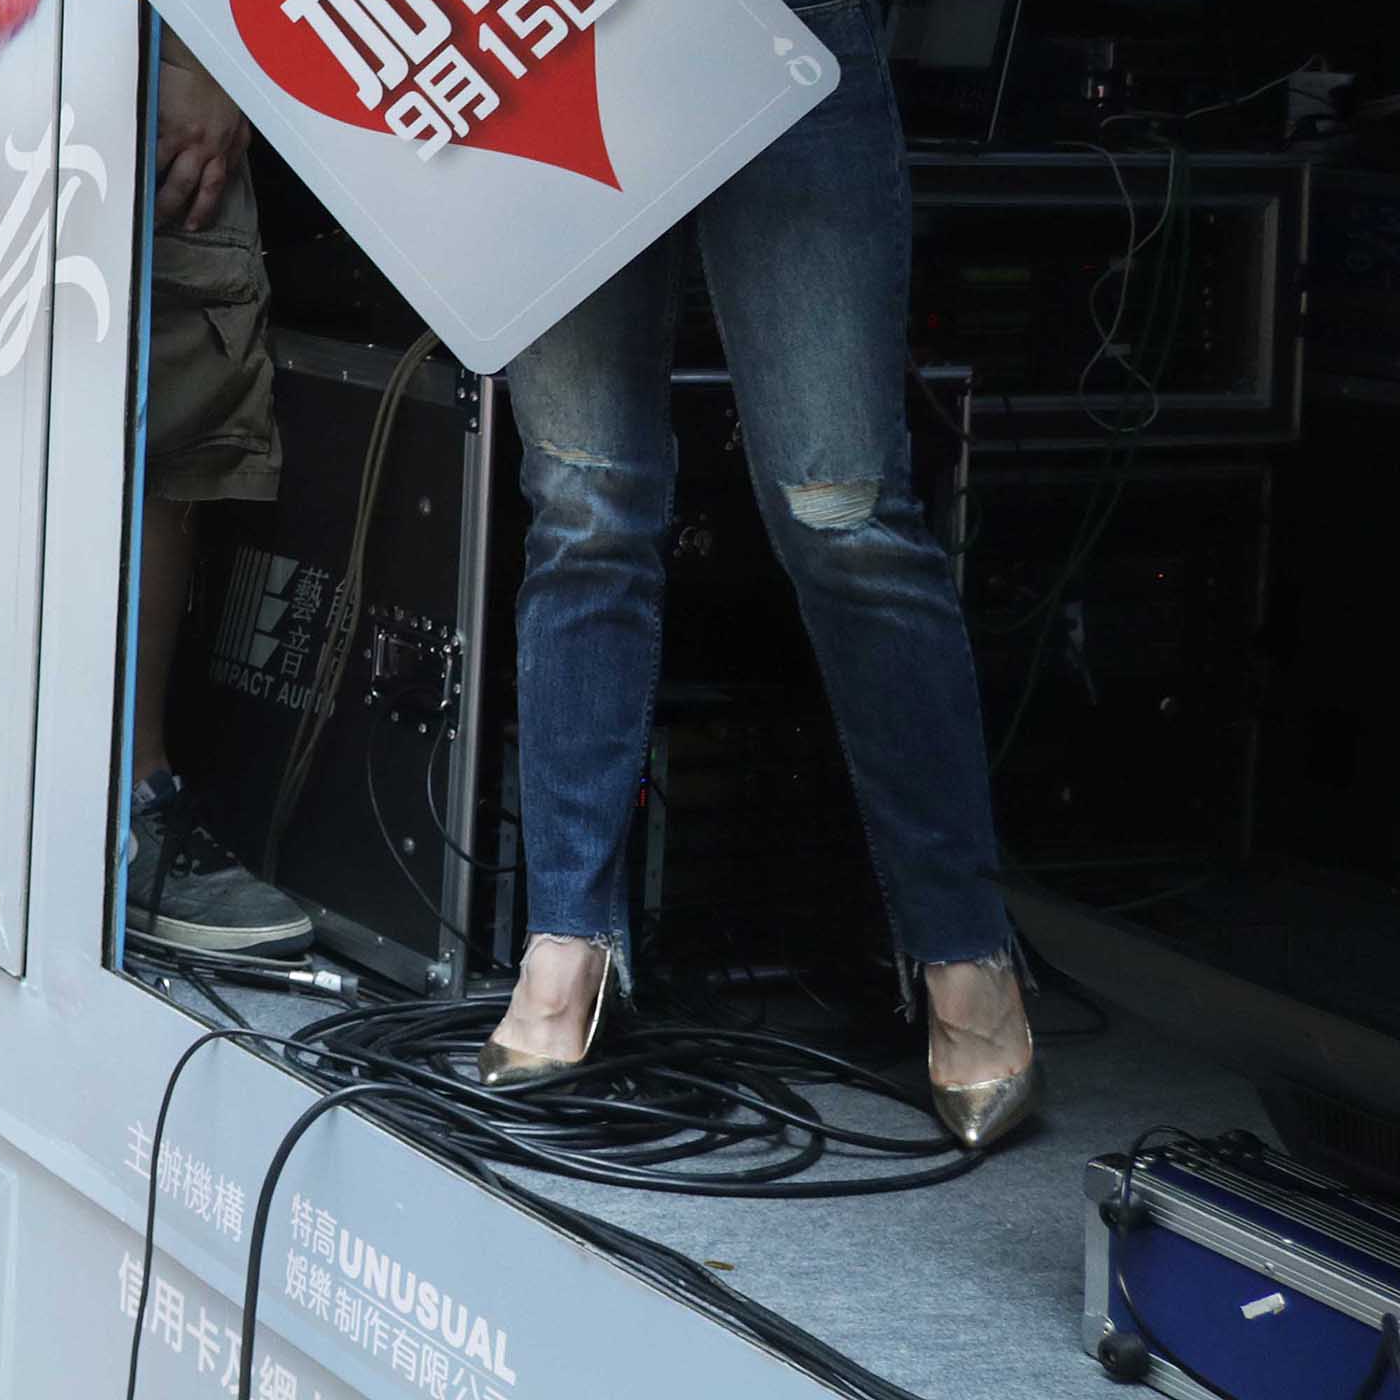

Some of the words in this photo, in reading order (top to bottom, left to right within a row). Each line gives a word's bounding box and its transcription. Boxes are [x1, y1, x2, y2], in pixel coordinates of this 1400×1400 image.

[124, 1119, 246, 1243] 主辦機構
[284, 1247, 332, 1322] 娛樂
[291, 1192, 338, 1265] 特高
[338, 1228, 517, 1387] UNUSUAL
